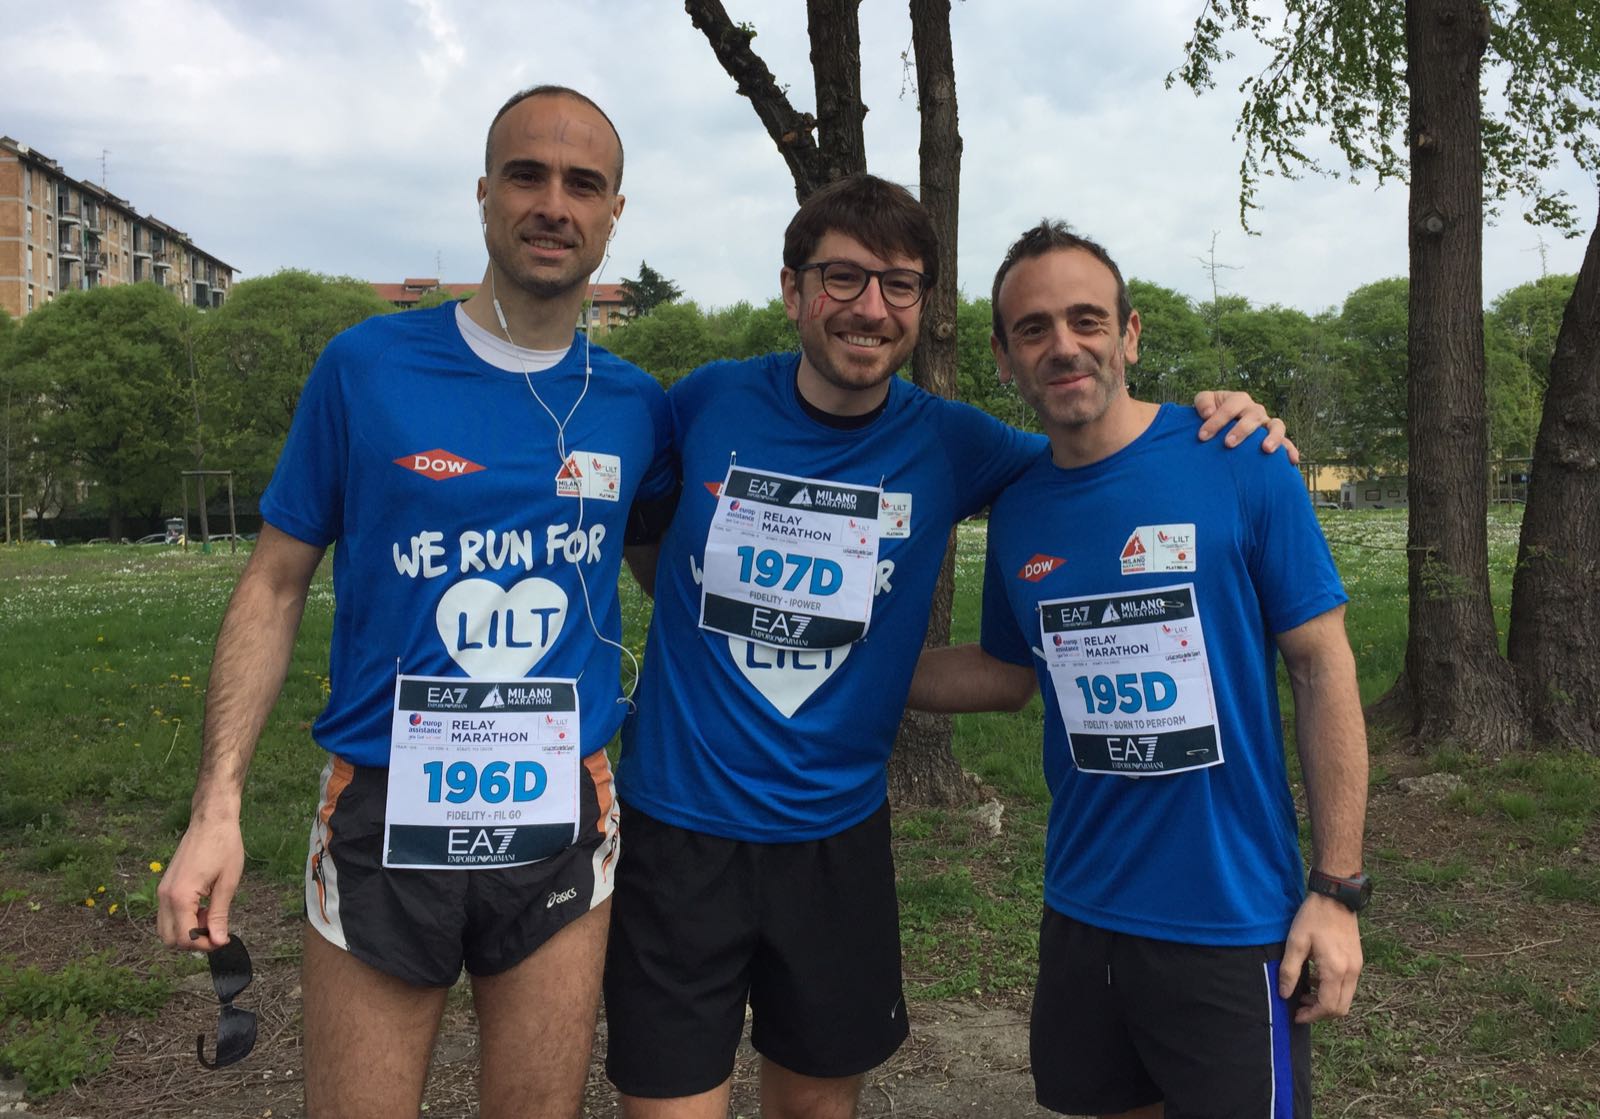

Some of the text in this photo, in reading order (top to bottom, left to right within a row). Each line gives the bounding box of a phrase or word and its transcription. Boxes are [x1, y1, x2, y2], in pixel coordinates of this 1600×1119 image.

[414, 455, 468, 473] DOW
[748, 478, 781, 497] EA7
[816, 489, 857, 503] MILANO
[815, 500, 857, 510] MARATHON
[763, 511, 802, 526] RELAY
[762, 523, 832, 542] MARATHON
[1173, 535, 1190, 543] LILT
[392, 523, 606, 579] WE RUN FOR
[737, 545, 843, 596] 197D
[1024, 560, 1054, 579] DOW
[750, 590, 783, 605] FIDELITY
[789, 598, 821, 611] IPOWER
[1120, 598, 1165, 611] MILANO
[1060, 605, 1090, 624] EA7
[1122, 607, 1166, 619] MARATHON
[457, 607, 561, 651] LILT
[751, 607, 812, 638] EA7
[1084, 634, 1117, 646] RELAY
[1086, 643, 1149, 658] MARATHON
[427, 687, 469, 704] EA7
[507, 688, 552, 699] MILANO
[1075, 671, 1178, 714] 195D
[507, 697, 552, 705] MARATHON
[422, 720, 442, 728] europ
[452, 720, 496, 730] RELAY
[1083, 720, 1109, 729] FIDELITY
[1114, 718, 1134, 729] BORN
[1134, 718, 1145, 728] TO
[1146, 715, 1186, 728] PERFORM
[451, 732, 528, 743] MARATHON
[1106, 736, 1158, 762] EA7
[423, 761, 548, 804] 196D
[446, 811, 486, 821] FIDELITY
[494, 810, 507, 820] FIL
[508, 810, 522, 820] GO
[448, 828, 517, 855] EA7
[447, 854, 516, 863] EMPORIO ARMANI
